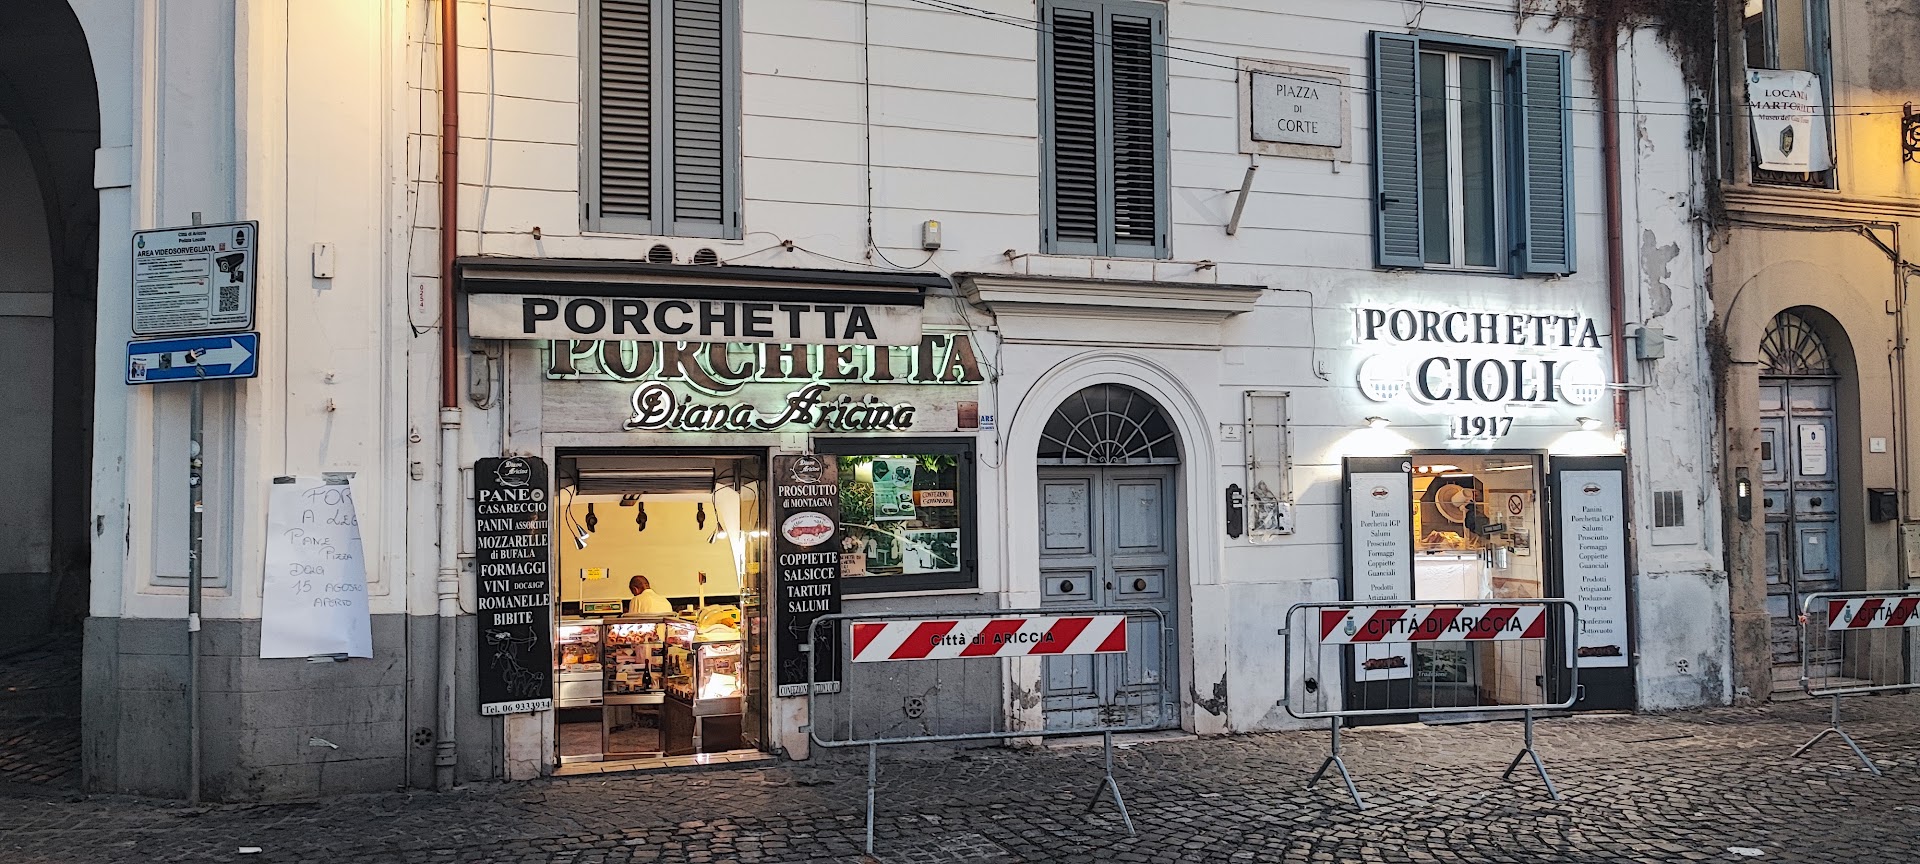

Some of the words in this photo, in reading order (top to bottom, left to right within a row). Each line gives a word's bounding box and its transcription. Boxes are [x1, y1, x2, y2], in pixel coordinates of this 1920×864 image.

[1276, 84, 1319, 100] PIAZZA
[1293, 104, 1302, 113] DI
[1277, 118, 1318, 134] CORTE
[137, 249, 154, 257] AREA
[155, 245, 216, 256] VIDEOSORVEGLIATA
[522, 297, 878, 340] PORCHETTA
[1363, 308, 1603, 348] PORCHETTA
[548, 334, 985, 392] PORCHETTA
[1416, 356, 1559, 402] CIOLI
[627, 384, 753, 428] Diana
[757, 384, 915, 428] Aricina
[1228, 426, 1234, 435] 2
[1459, 416, 1514, 437] 1917
[478, 488, 531, 502] PANE
[778, 484, 837, 497] PROSCIUTTO
[478, 502, 547, 514] CASARECCIO
[782, 499, 790, 508] di
[790, 498, 833, 508] MONTAGNA
[477, 518, 513, 531] PANINI
[515, 520, 548, 530] ASSORTITI
[1360, 519, 1388, 528] Porchetta
[1389, 519, 1401, 527] IGP
[1571, 514, 1600, 522] Porchetta
[1601, 514, 1614, 522] IGP
[1370, 529, 1391, 537] Salumi
[1577, 533, 1609, 541] Prosciutto
[477, 534, 548, 549] MOZZARELLE
[1367, 539, 1396, 547] Prosciutto
[1579, 543, 1608, 551] Formaggi
[490, 550, 499, 560] di
[500, 549, 536, 560] BUFALA
[779, 552, 838, 566] COPPIETTE
[1368, 549, 1395, 558] Formaggi
[1578, 552, 1609, 561] Coppiette
[480, 561, 546, 577] FORMAGGI
[1367, 559, 1396, 568] Coppiette
[1578, 561, 1609, 569] Guanciali
[784, 567, 835, 581] SALSICCE
[1367, 569, 1396, 577] Guanciali
[291, 580, 312, 595] 15
[483, 579, 510, 593] VINI
[787, 584, 832, 597] TARTUFI
[1370, 583, 1394, 591] Prodotti
[1580, 584, 1612, 593] Artigianali
[478, 594, 550, 610] ROMANELLE
[788, 599, 830, 612] SALUMI
[1584, 604, 1607, 612] Propria
[493, 611, 534, 625] BIBITE
[1426, 618, 1443, 633] DI
[1447, 616, 1523, 633] ARICCIA
[930, 634, 966, 647] Città
[971, 633, 985, 645] di
[992, 631, 1055, 645] ARICCIA
[483, 705, 500, 714] Tel.
[502, 704, 513, 712] 06
